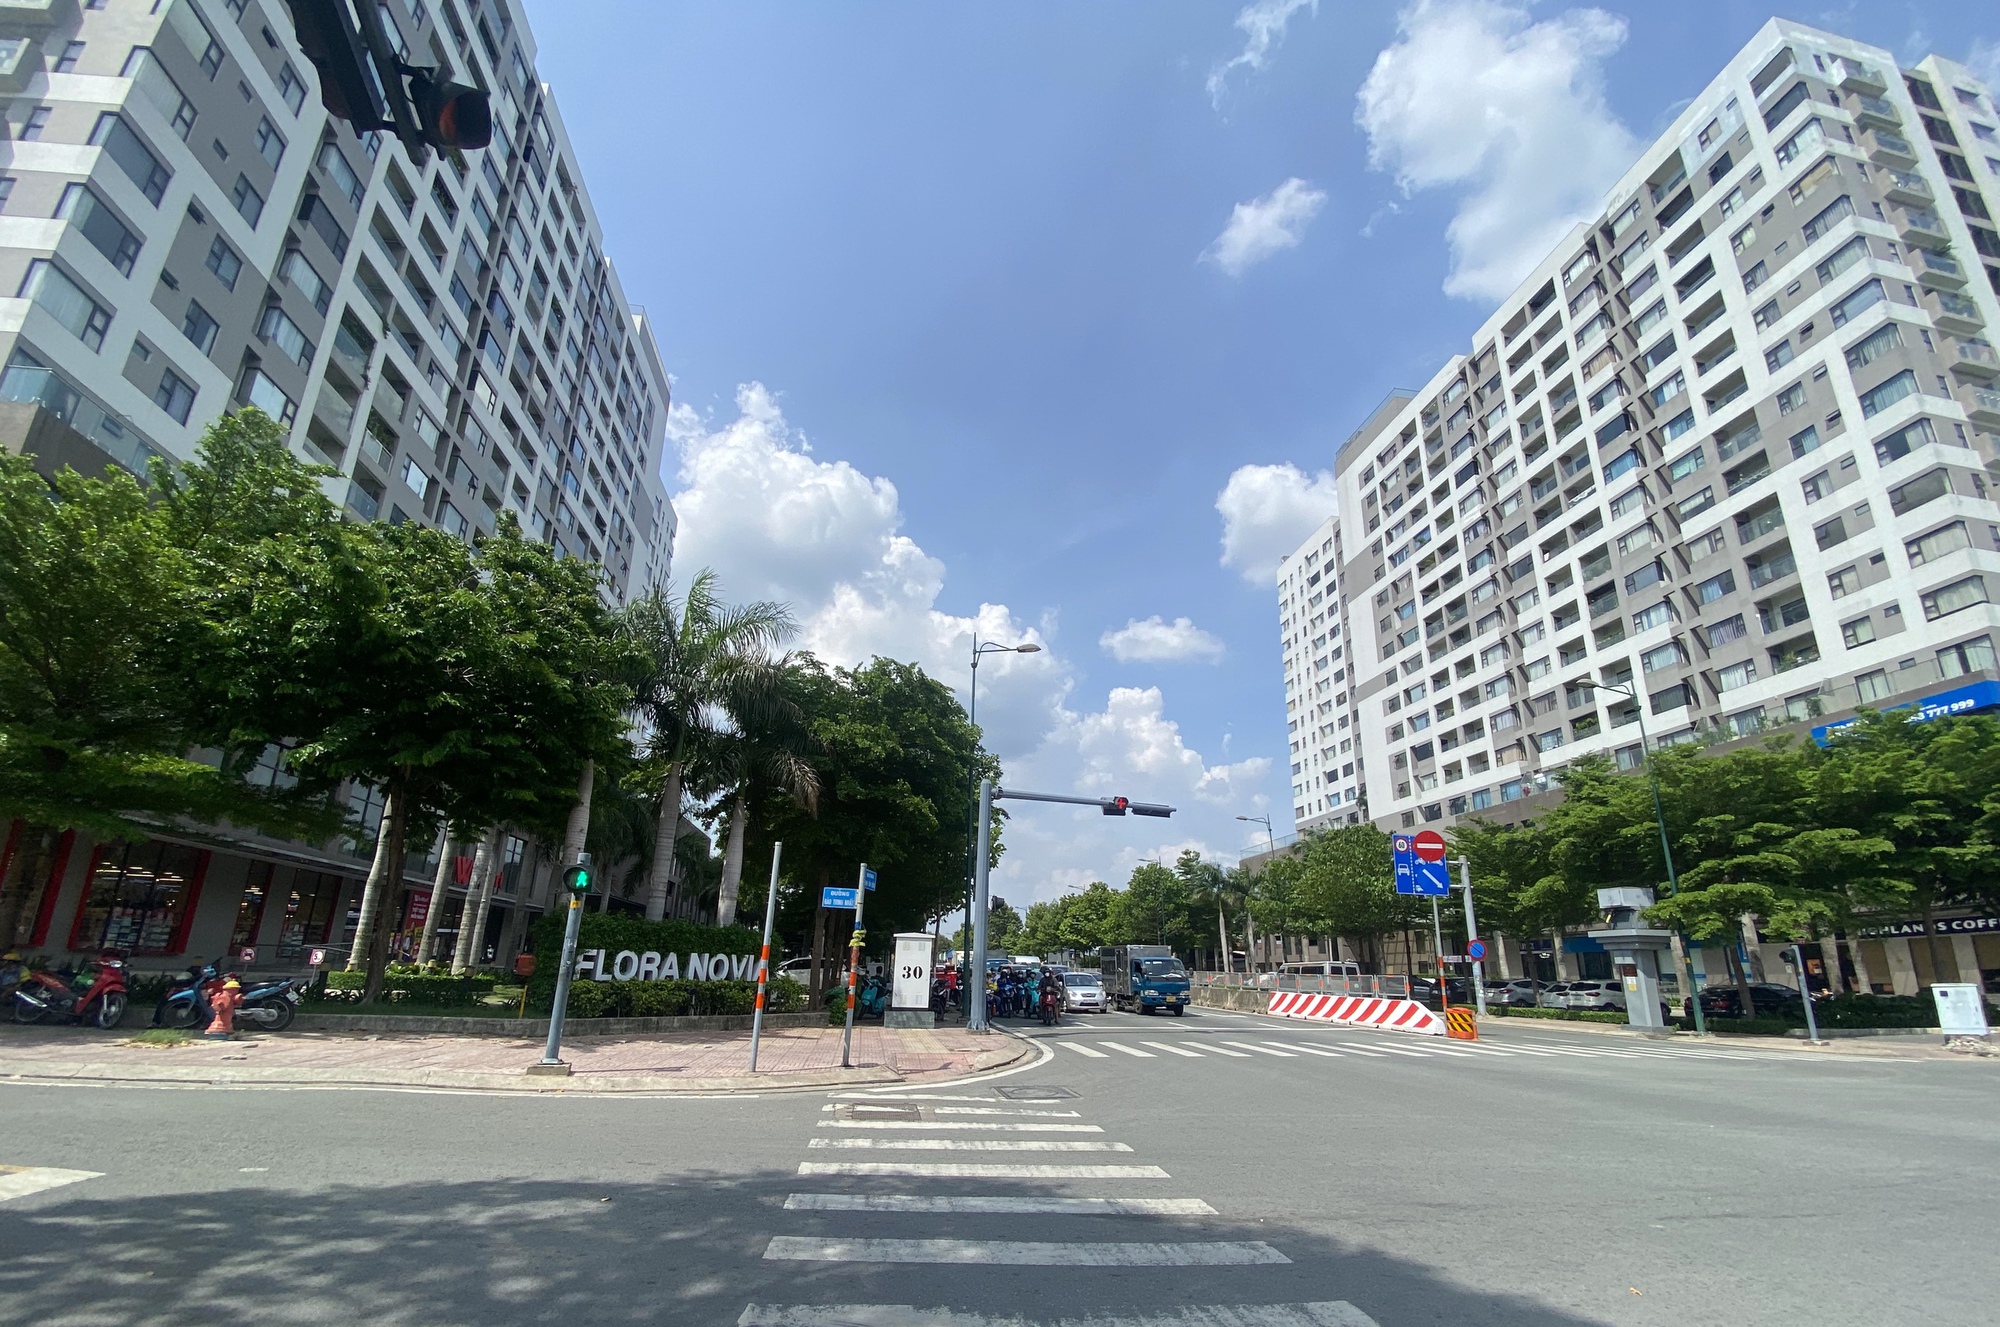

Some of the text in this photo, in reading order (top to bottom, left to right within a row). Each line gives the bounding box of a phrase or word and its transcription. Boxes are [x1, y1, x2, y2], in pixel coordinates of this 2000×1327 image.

[1926, 705, 1949, 718] 777
[1950, 698, 1975, 712] 999
[1398, 841, 1405, 849] 60
[1951, 918, 2000, 930] COFF
[573, 949, 680, 982] FLORA
[901, 965, 923, 979] 30
